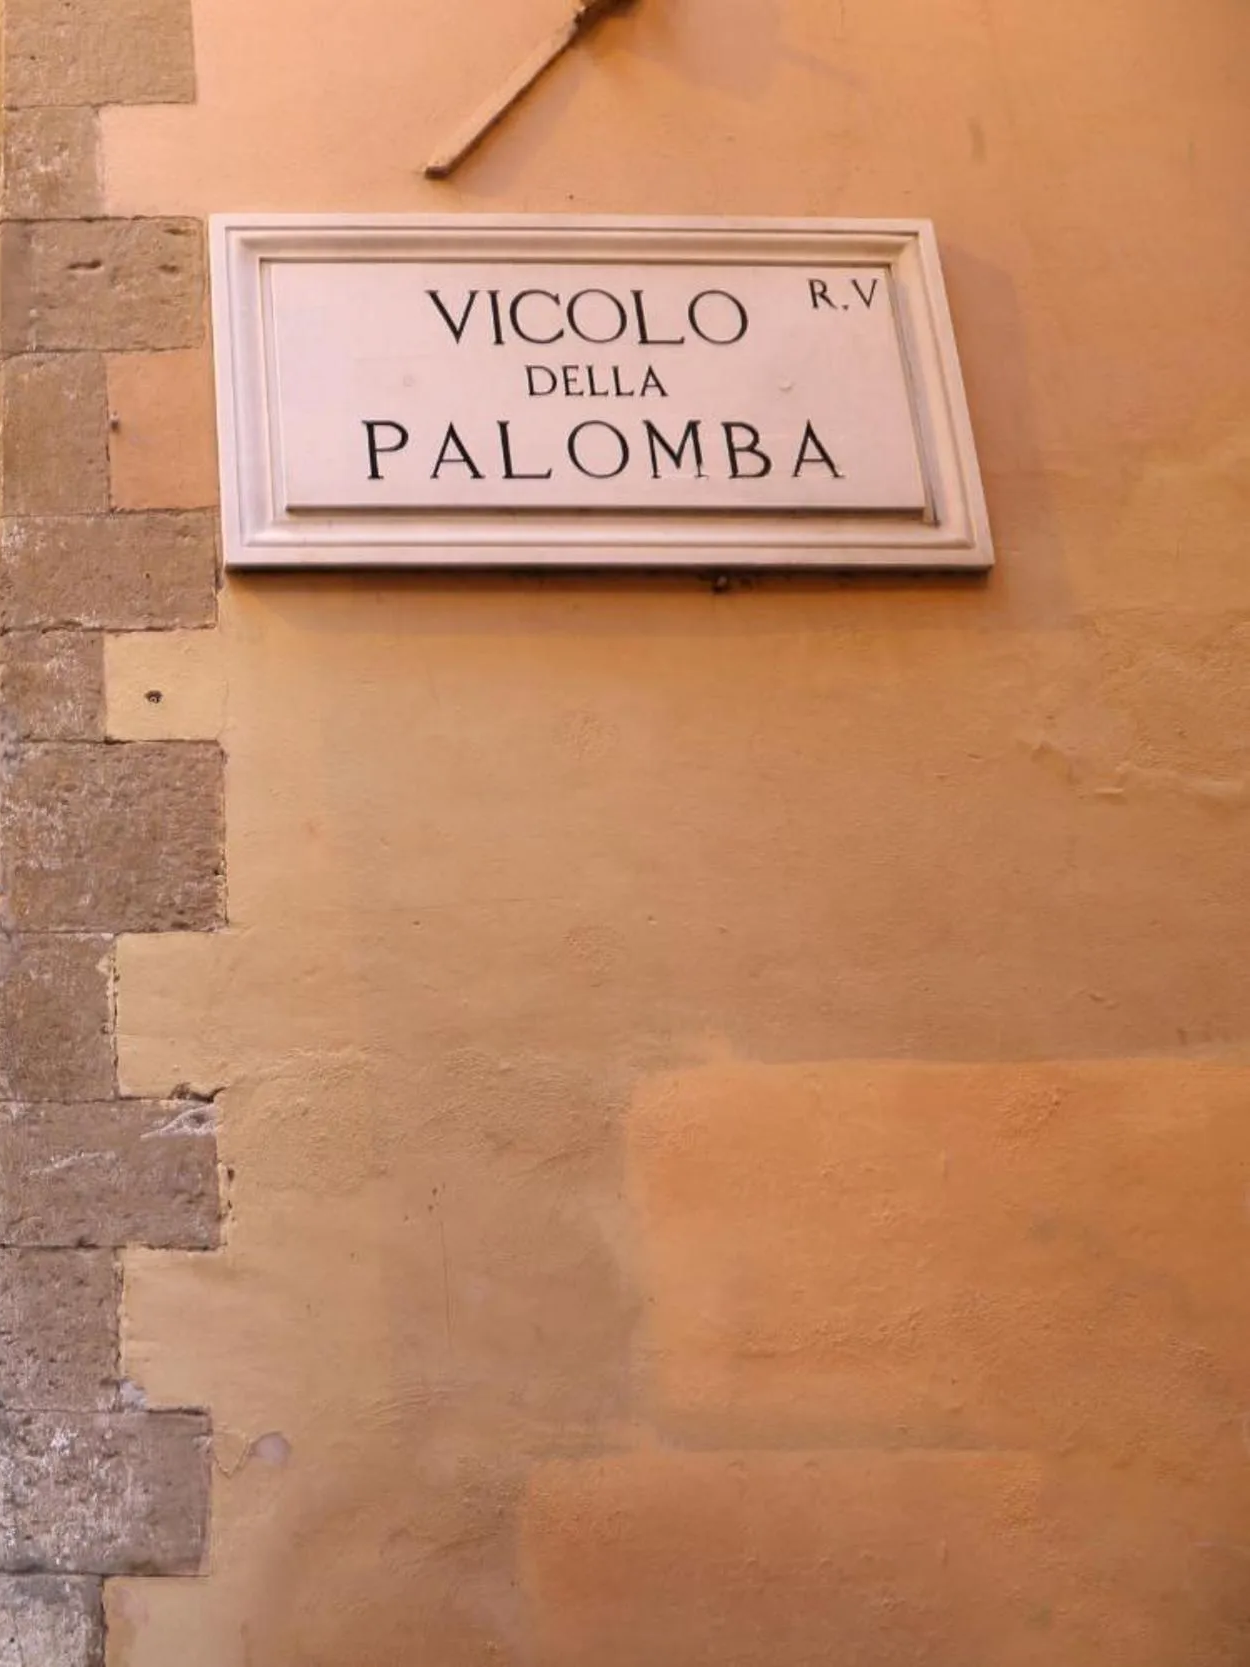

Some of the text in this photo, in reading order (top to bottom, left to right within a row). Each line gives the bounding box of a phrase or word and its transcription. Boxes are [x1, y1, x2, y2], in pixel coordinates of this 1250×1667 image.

[426, 288, 749, 346] VICOLO
[807, 278, 879, 311] R.V
[524, 364, 669, 398] DELLA
[361, 419, 846, 480] PALOMBA
